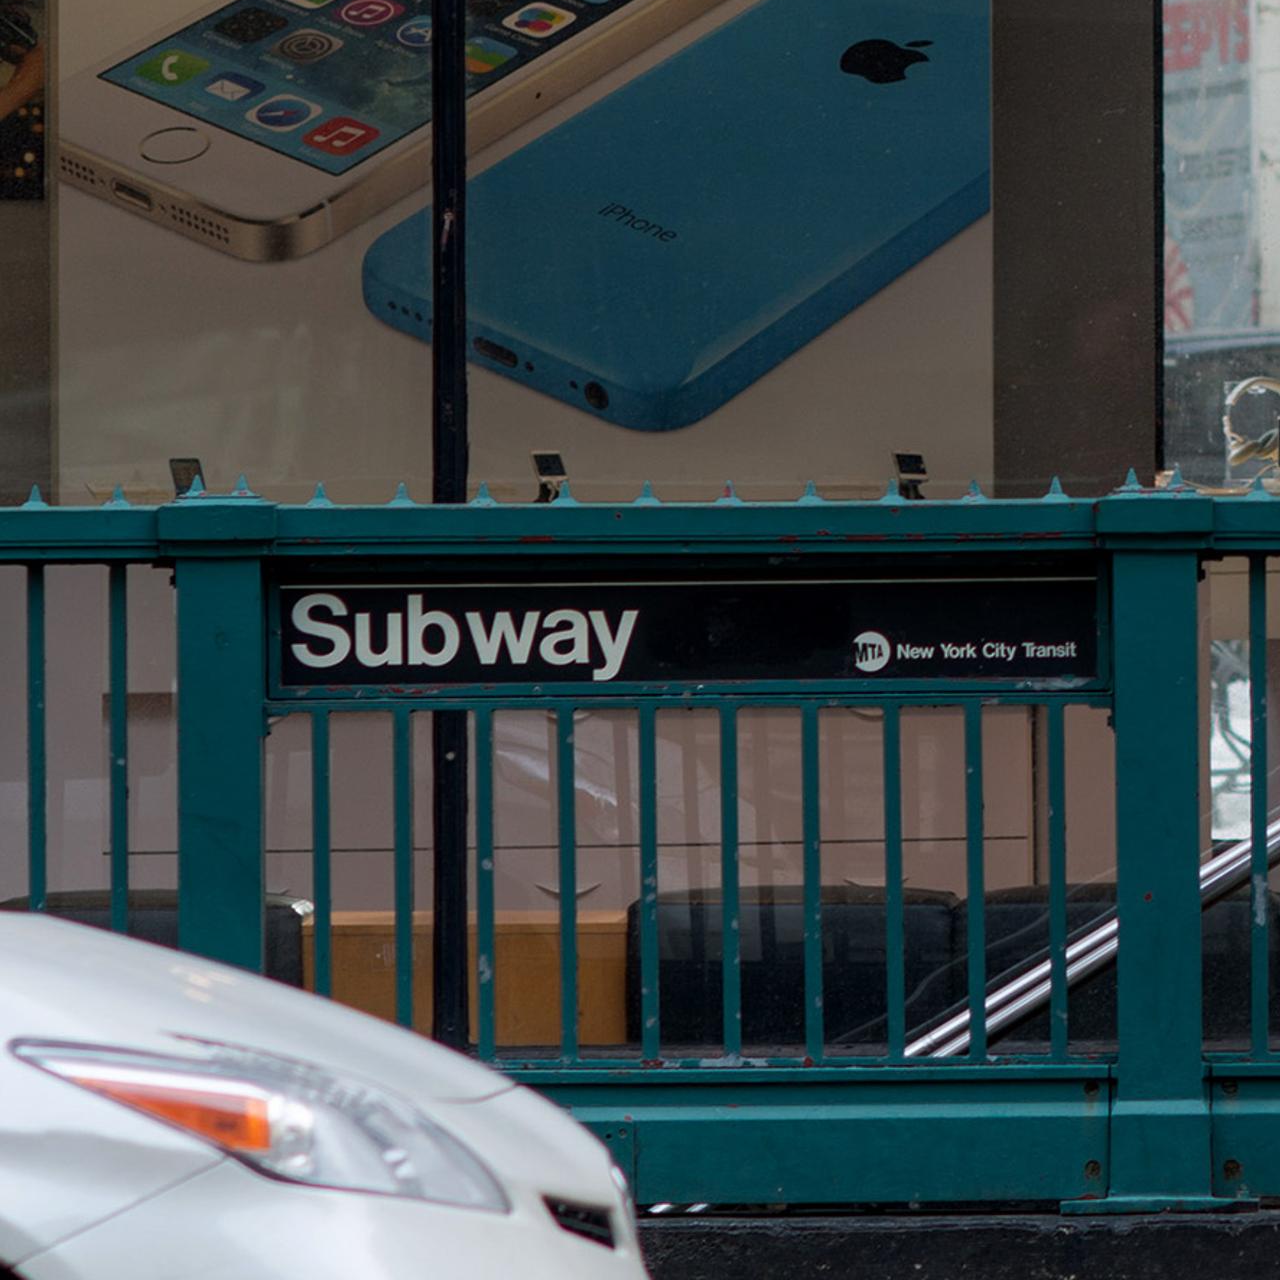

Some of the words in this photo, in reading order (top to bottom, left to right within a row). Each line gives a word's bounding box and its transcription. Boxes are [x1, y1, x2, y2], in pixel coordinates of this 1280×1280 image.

[597, 201, 678, 243] iPhone
[290, 592, 640, 683] Subway
[854, 639, 886, 666] MTA
[896, 642, 935, 660] New
[940, 642, 977, 659] York
[982, 641, 1017, 662] City
[1021, 640, 1078, 659] Transit
